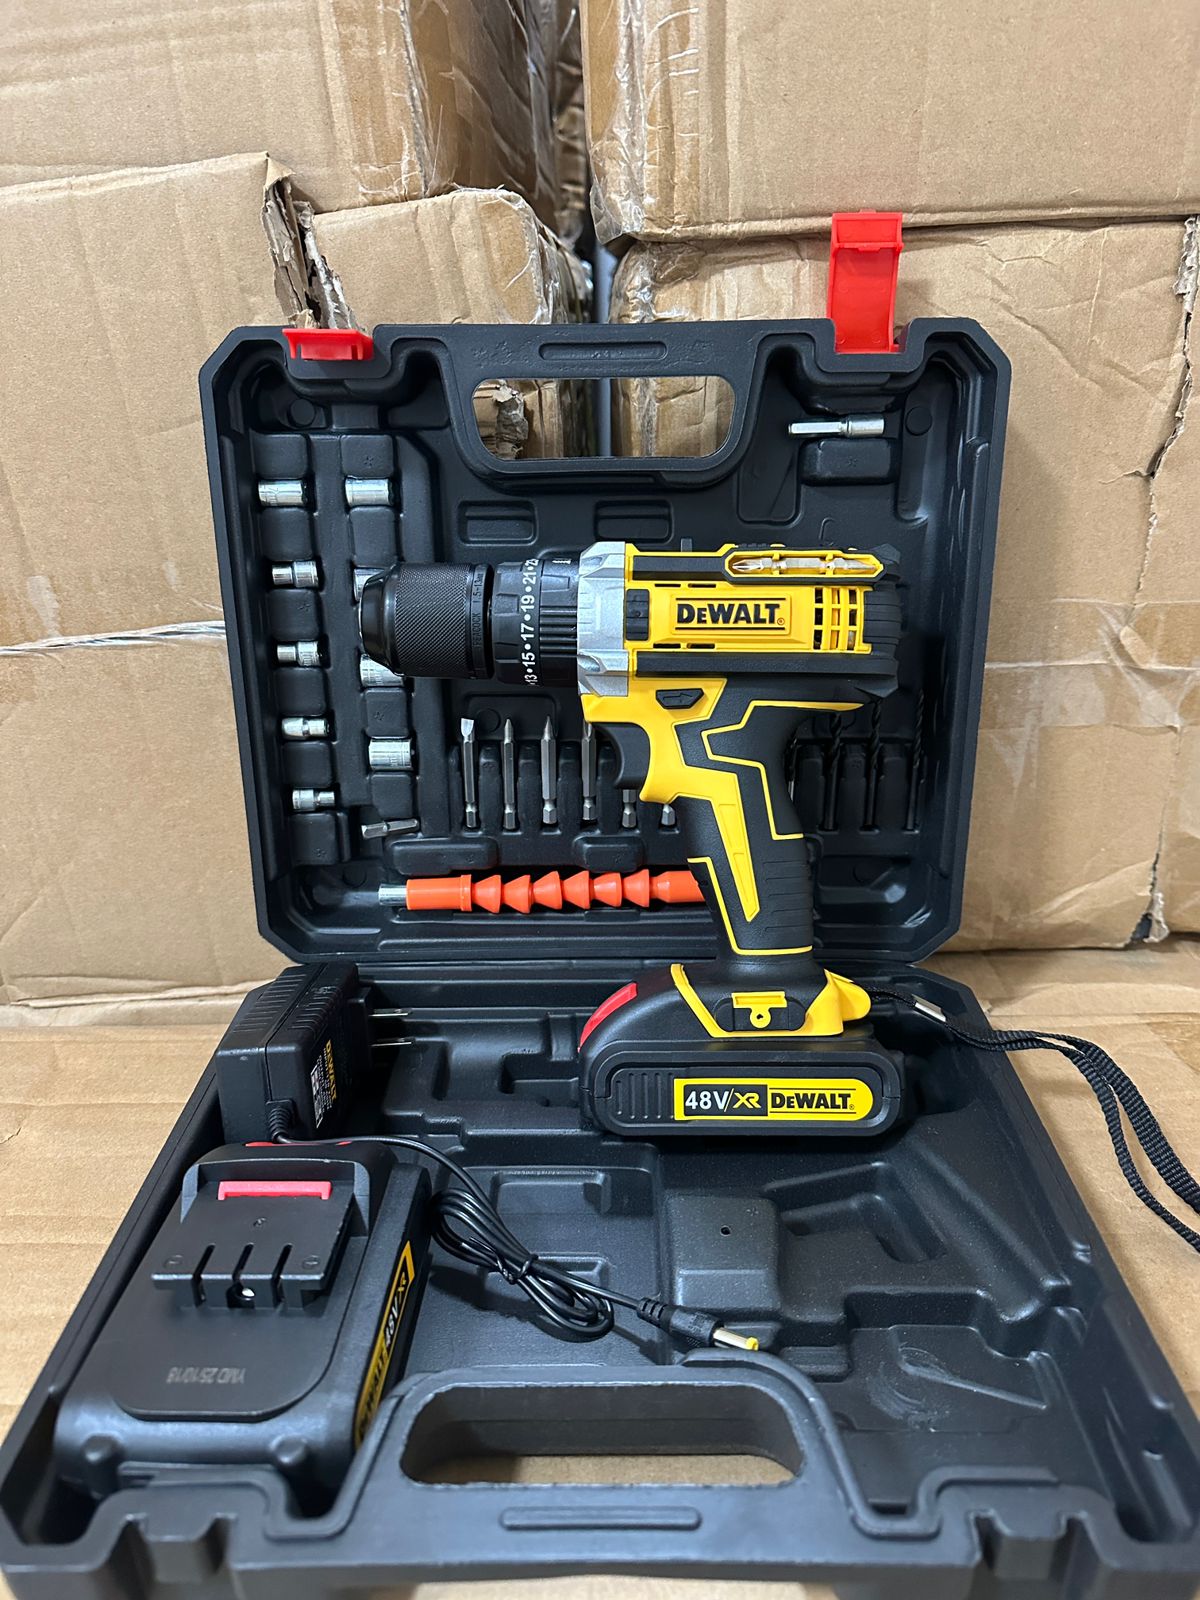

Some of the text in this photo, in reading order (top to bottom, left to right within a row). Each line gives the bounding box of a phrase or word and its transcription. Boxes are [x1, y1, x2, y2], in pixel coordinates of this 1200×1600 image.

[522, 571, 537, 585] 21
[520, 594, 535, 611] 19
[472, 613, 481, 648] PEACOCK
[520, 623, 535, 641] 17
[521, 652, 536, 667] 15
[217, 1367, 246, 1384] YMD
